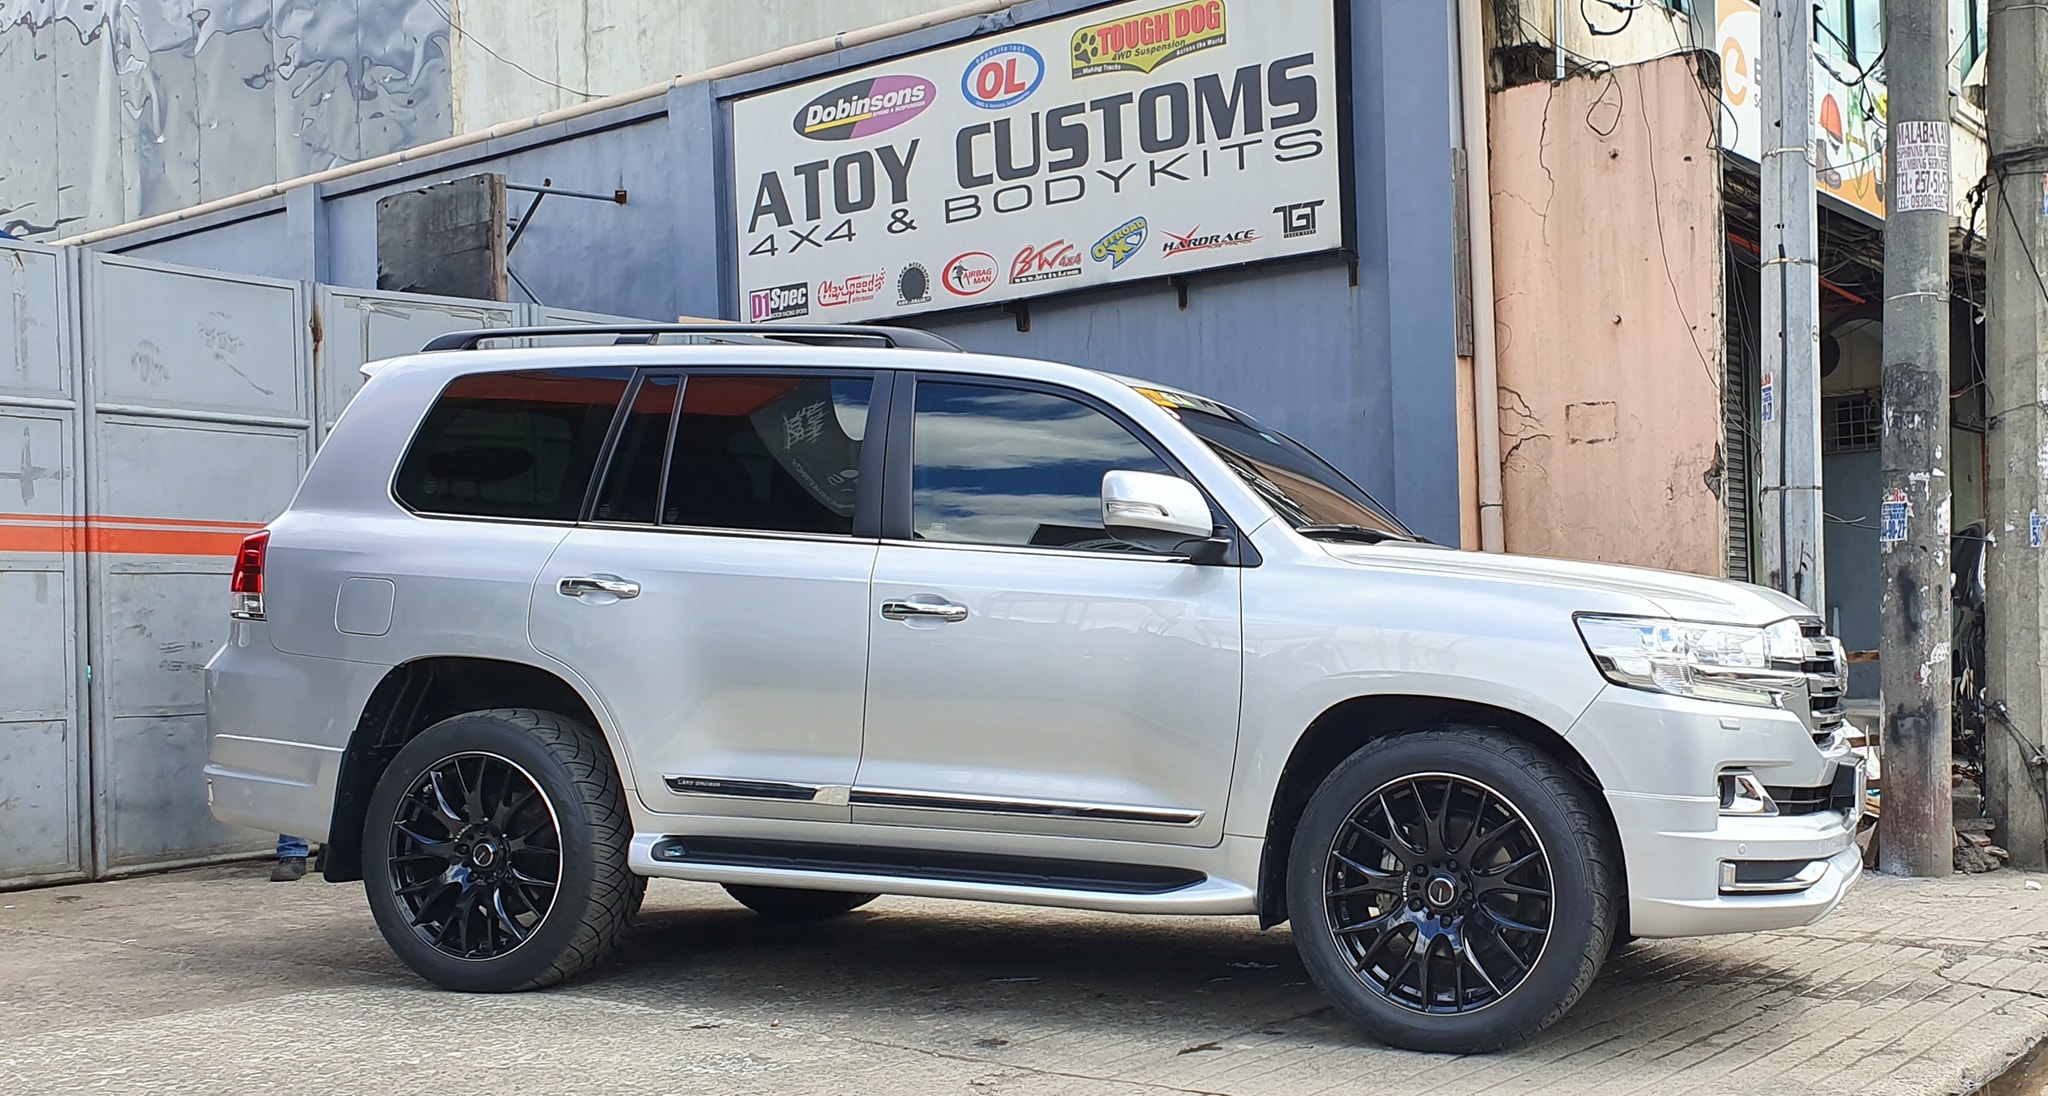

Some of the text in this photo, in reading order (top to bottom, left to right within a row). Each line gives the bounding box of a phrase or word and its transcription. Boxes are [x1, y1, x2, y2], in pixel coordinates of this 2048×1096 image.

[1096, 1, 1221, 56] TOUGH DOG
[1206, 37, 1224, 47] World
[1111, 39, 1186, 62] 4WD Suspension
[976, 57, 1026, 100] OL
[806, 84, 925, 127] Dobinsons
[748, 52, 1319, 233] ATOY CUSTOMS
[888, 208, 918, 235] &
[945, 129, 1324, 223] BODYKITS
[1272, 199, 1325, 234] TGT
[1094, 220, 1145, 259] OFFROAD
[1162, 228, 1256, 252] HARDRACE
[963, 267, 993, 281] AIRBAG
[973, 275, 992, 285] MAN
